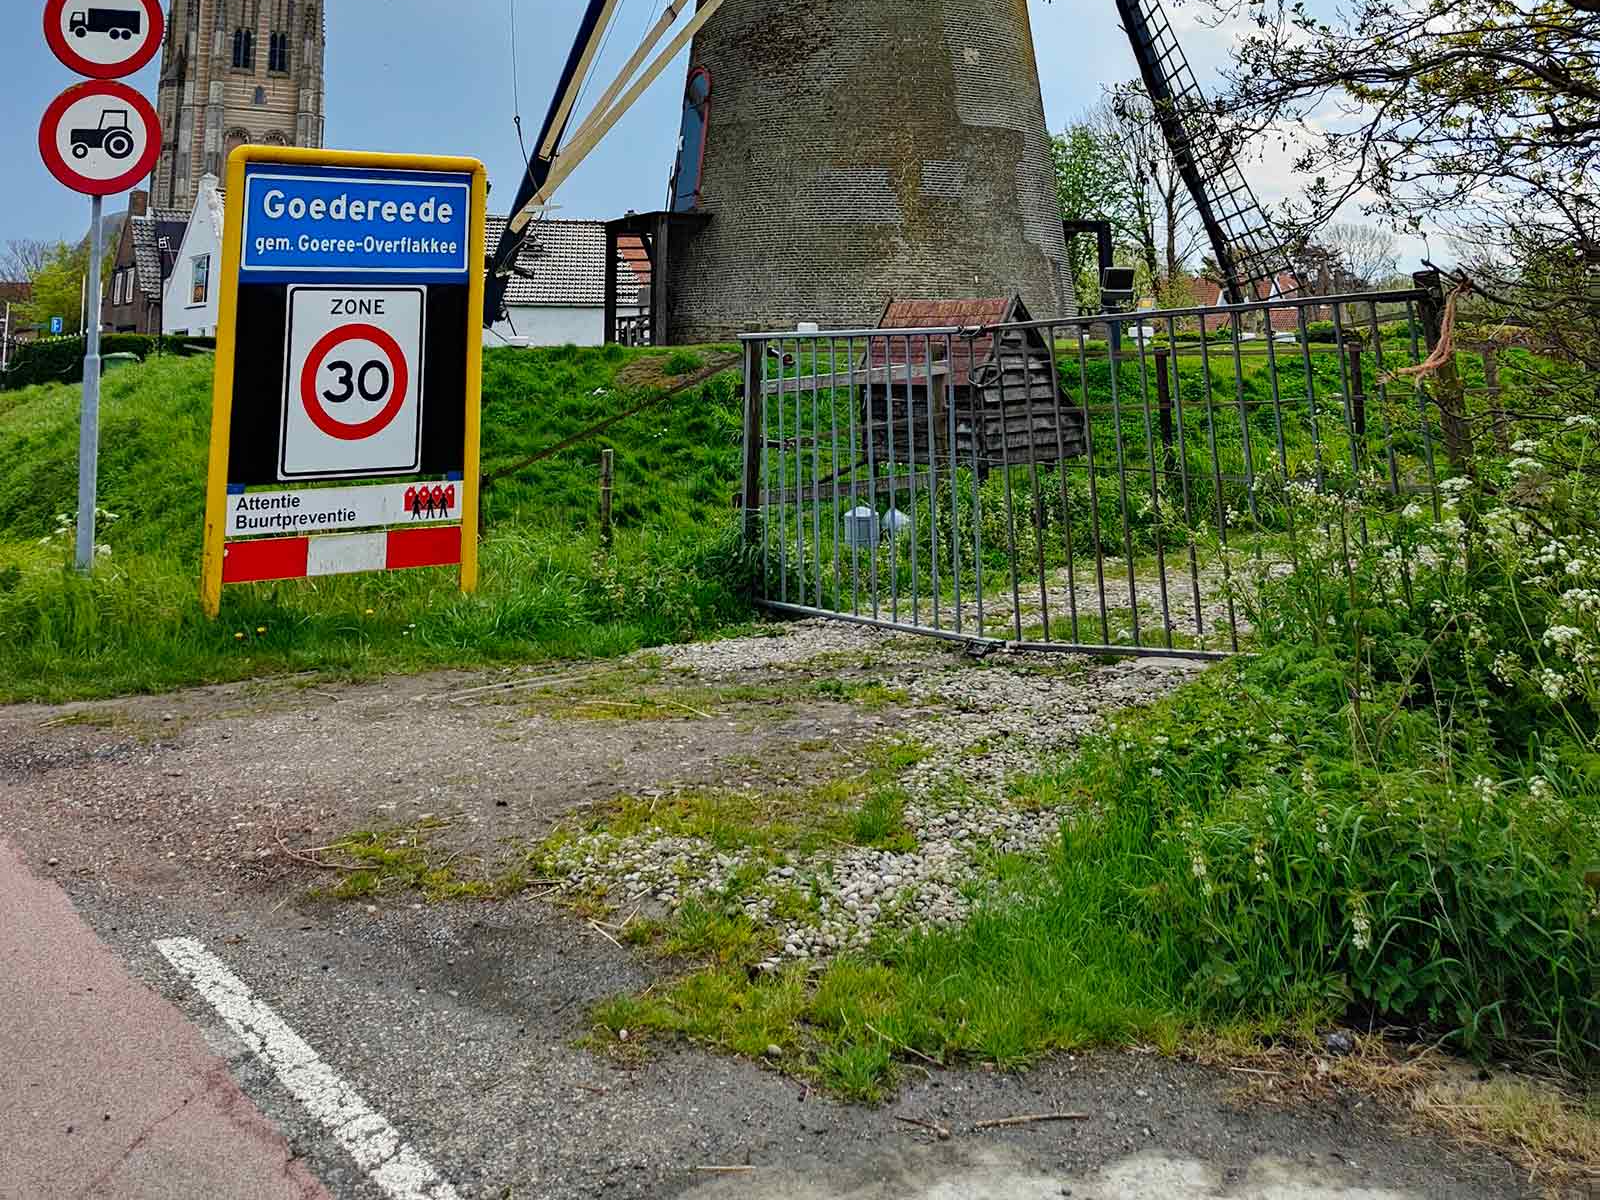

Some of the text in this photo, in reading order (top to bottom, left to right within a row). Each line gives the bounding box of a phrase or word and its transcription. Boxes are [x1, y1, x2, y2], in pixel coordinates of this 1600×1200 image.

[263, 189, 454, 224] Goedereede
[255, 234, 457, 255] gem. Goeree-Overflakkee
[330, 298, 385, 315] ZONE
[322, 359, 390, 403] 30
[236, 494, 300, 511] Attentie
[235, 508, 356, 530] Buurtpreventie
